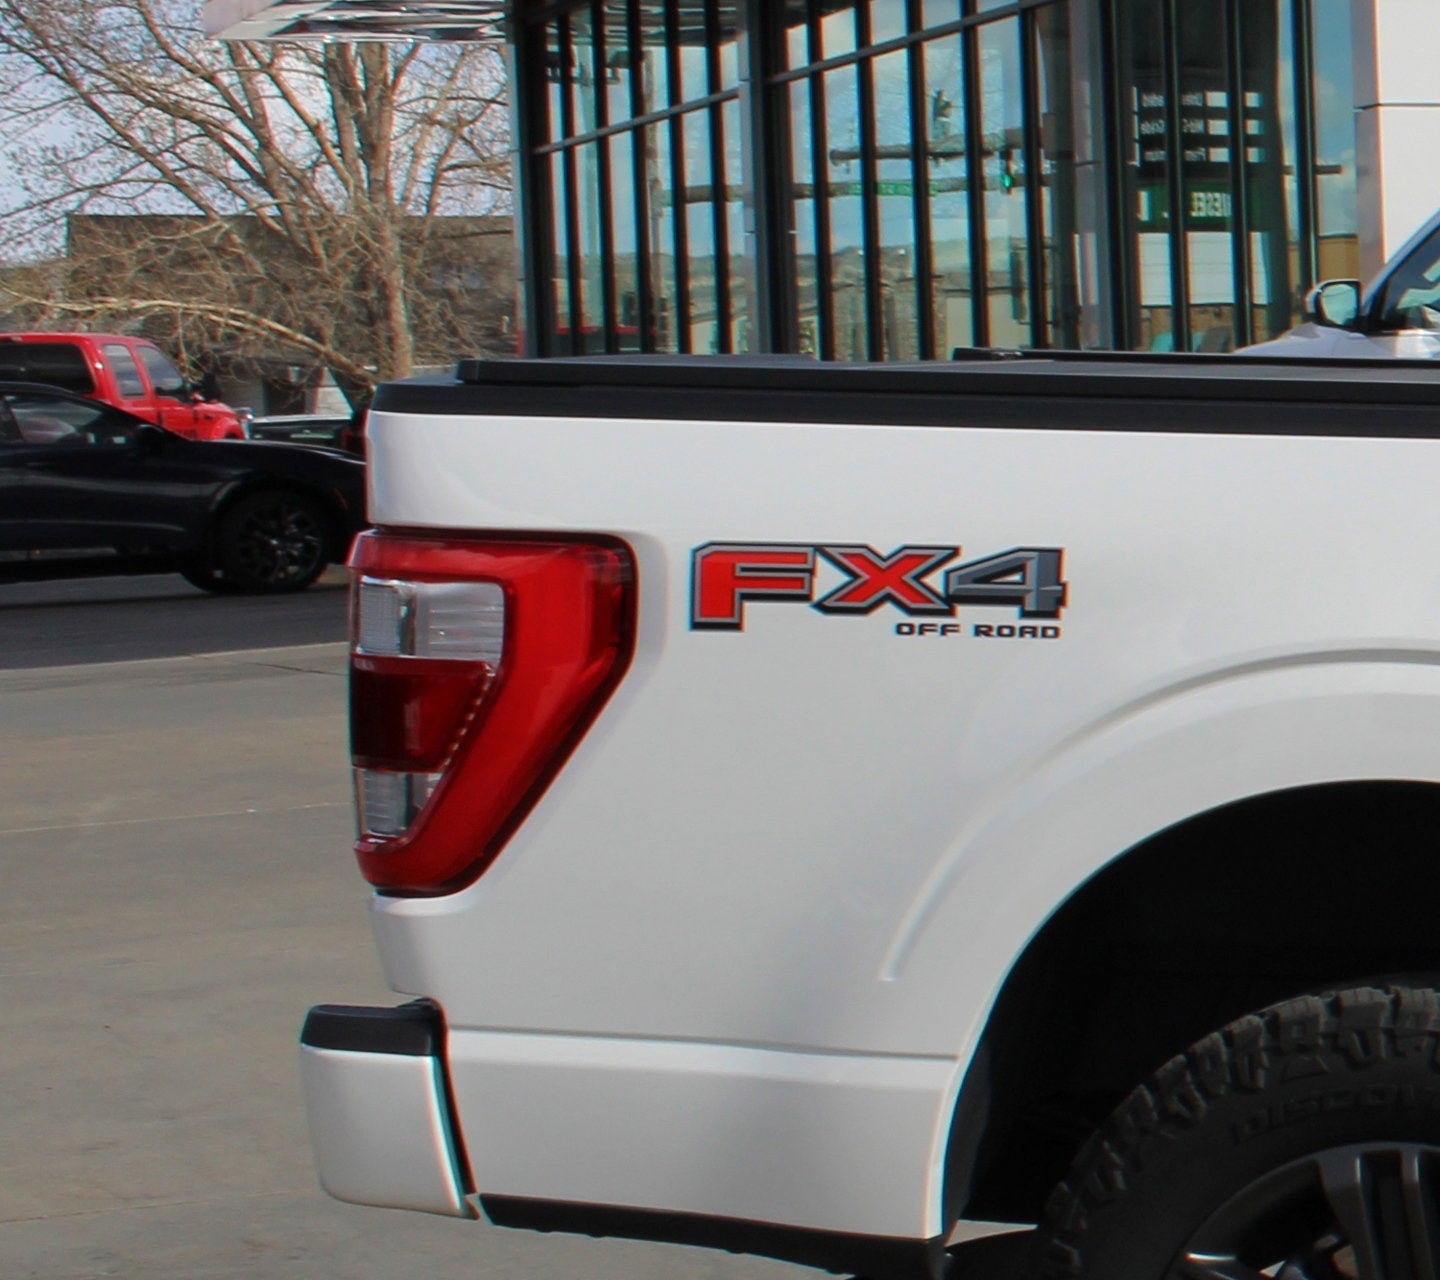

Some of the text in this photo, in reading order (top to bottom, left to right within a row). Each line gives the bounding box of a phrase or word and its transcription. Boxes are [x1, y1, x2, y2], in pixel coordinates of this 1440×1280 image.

[690, 539, 1069, 632] FX4
[895, 622, 1062, 640] OFF ROAD
